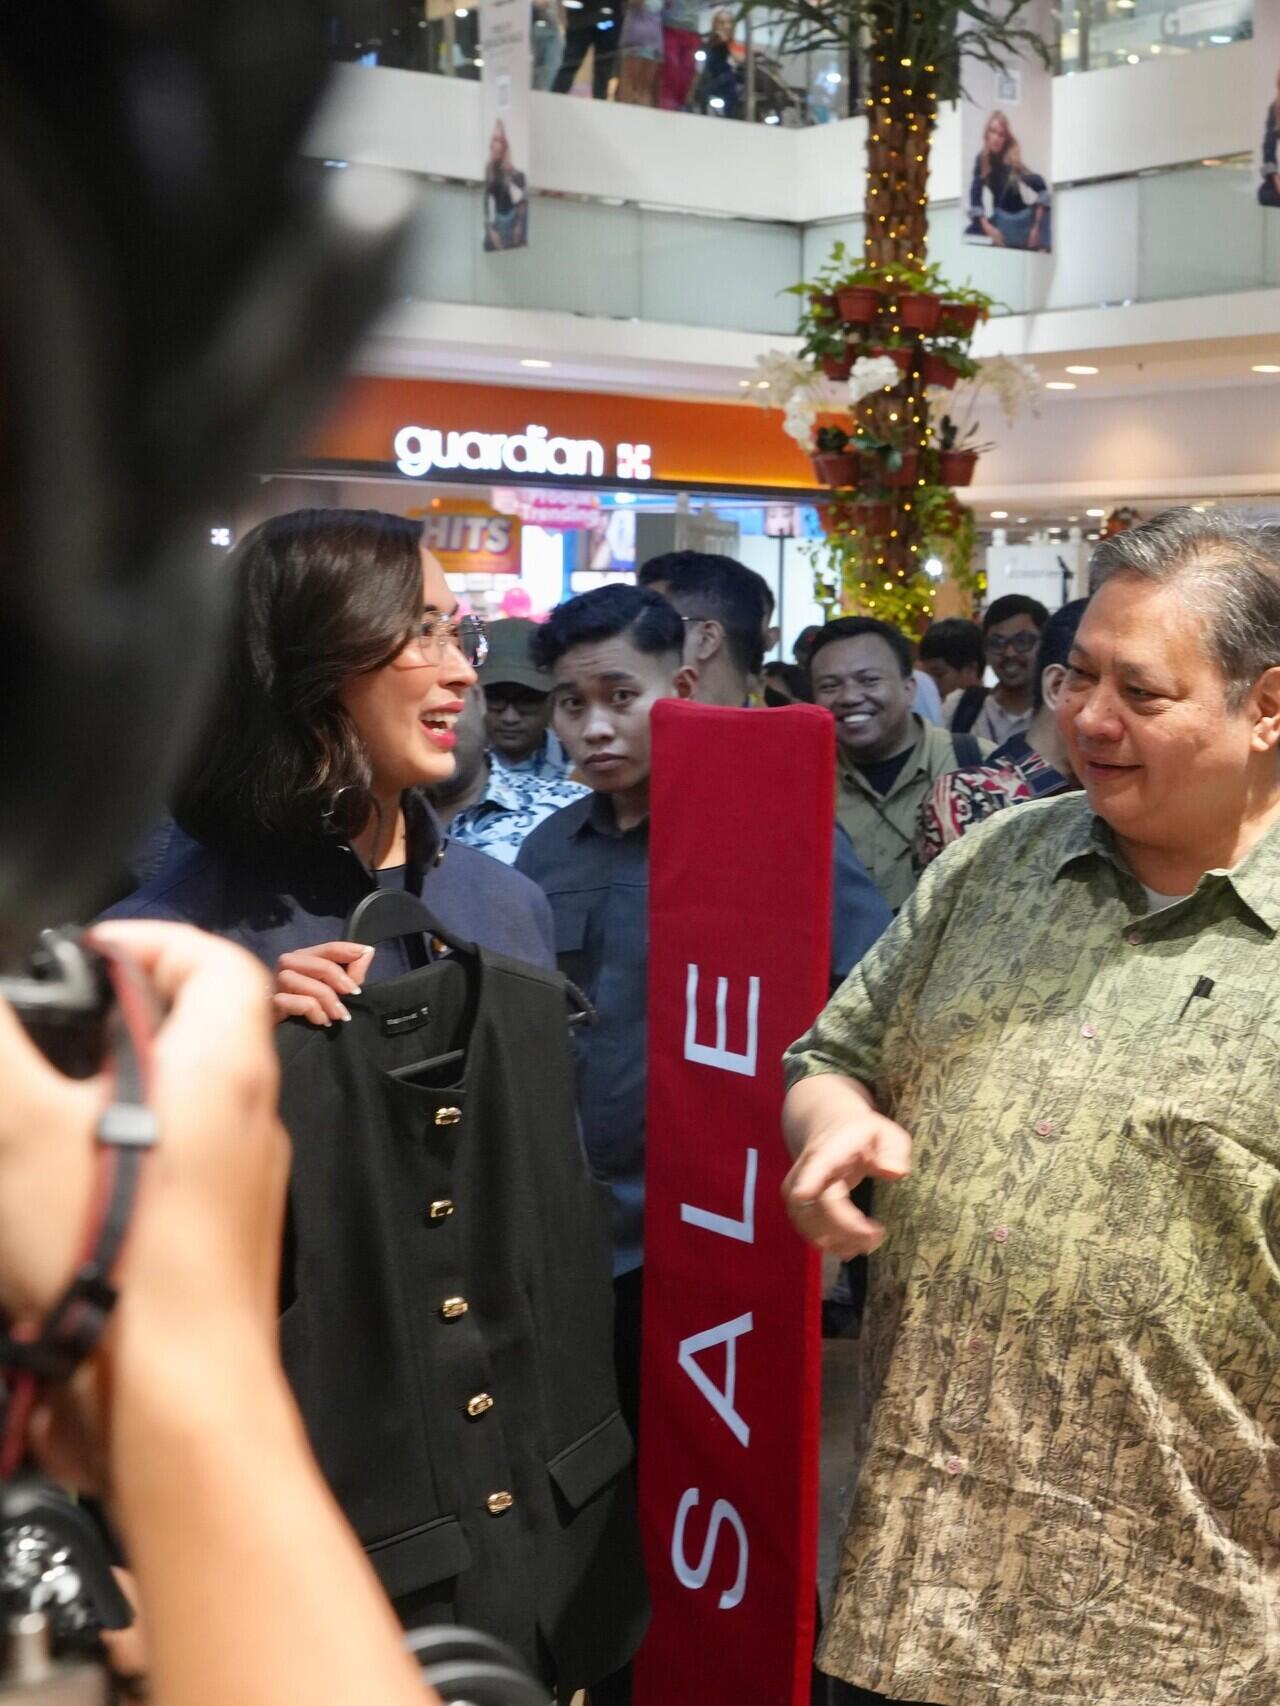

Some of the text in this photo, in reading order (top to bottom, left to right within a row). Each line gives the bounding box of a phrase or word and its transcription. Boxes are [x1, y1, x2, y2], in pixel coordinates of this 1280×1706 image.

[395, 425, 603, 476] guardian
[421, 513, 512, 553] HITS
[670, 962, 761, 1610] SALE
